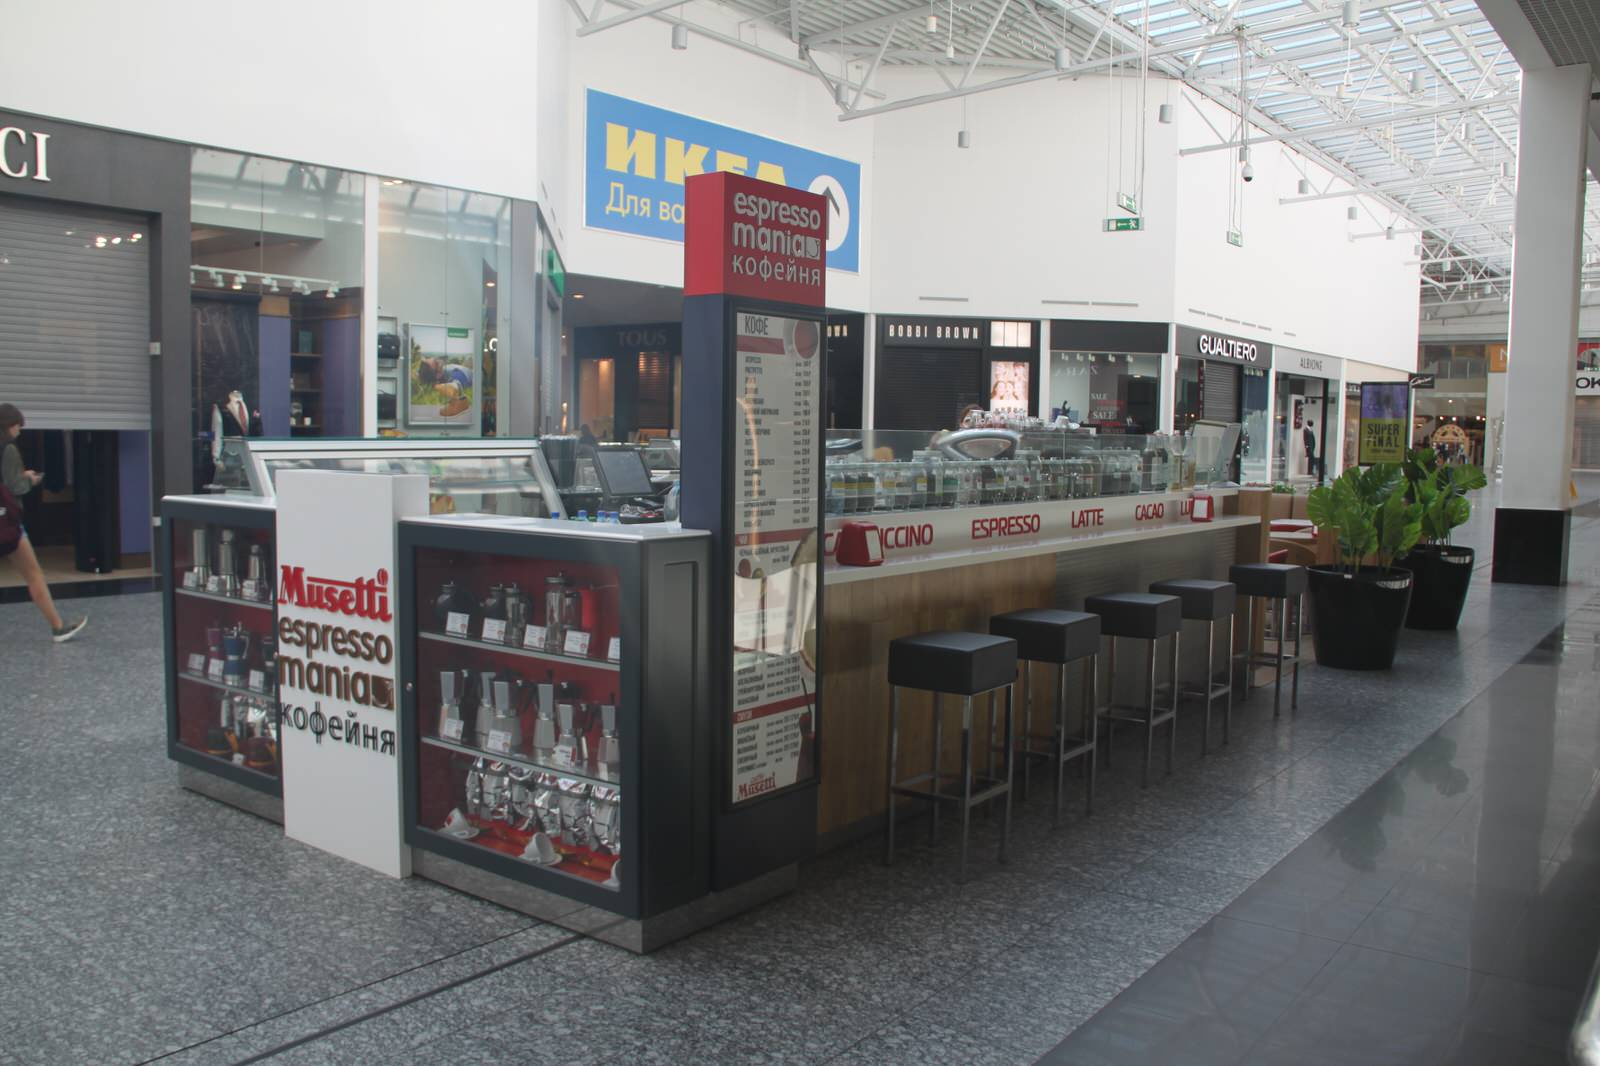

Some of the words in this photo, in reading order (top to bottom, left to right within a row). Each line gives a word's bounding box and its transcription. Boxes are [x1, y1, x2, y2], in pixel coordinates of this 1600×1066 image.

[606, 182, 651, 217] Для
[734, 192, 820, 230] espresso
[733, 221, 805, 258] mania
[732, 254, 821, 286] кофейня
[616, 329, 667, 347] TOUS
[745, 315, 768, 335] КОФЕ
[889, 324, 928, 338] BOBBI
[937, 326, 979, 339] BROWN
[1199, 334, 1257, 362] GUALTIERO
[1368, 424, 1399, 436] SUPER
[971, 514, 1040, 540] ESPRESSO
[1071, 508, 1104, 529] LATTE
[1136, 503, 1165, 521] CACAO
[278, 565, 392, 622] Musetti
[279, 616, 394, 665] espresso
[279, 655, 371, 707] mania
[281, 701, 396, 756] кофейня
[738, 772, 776, 799] Musetti
